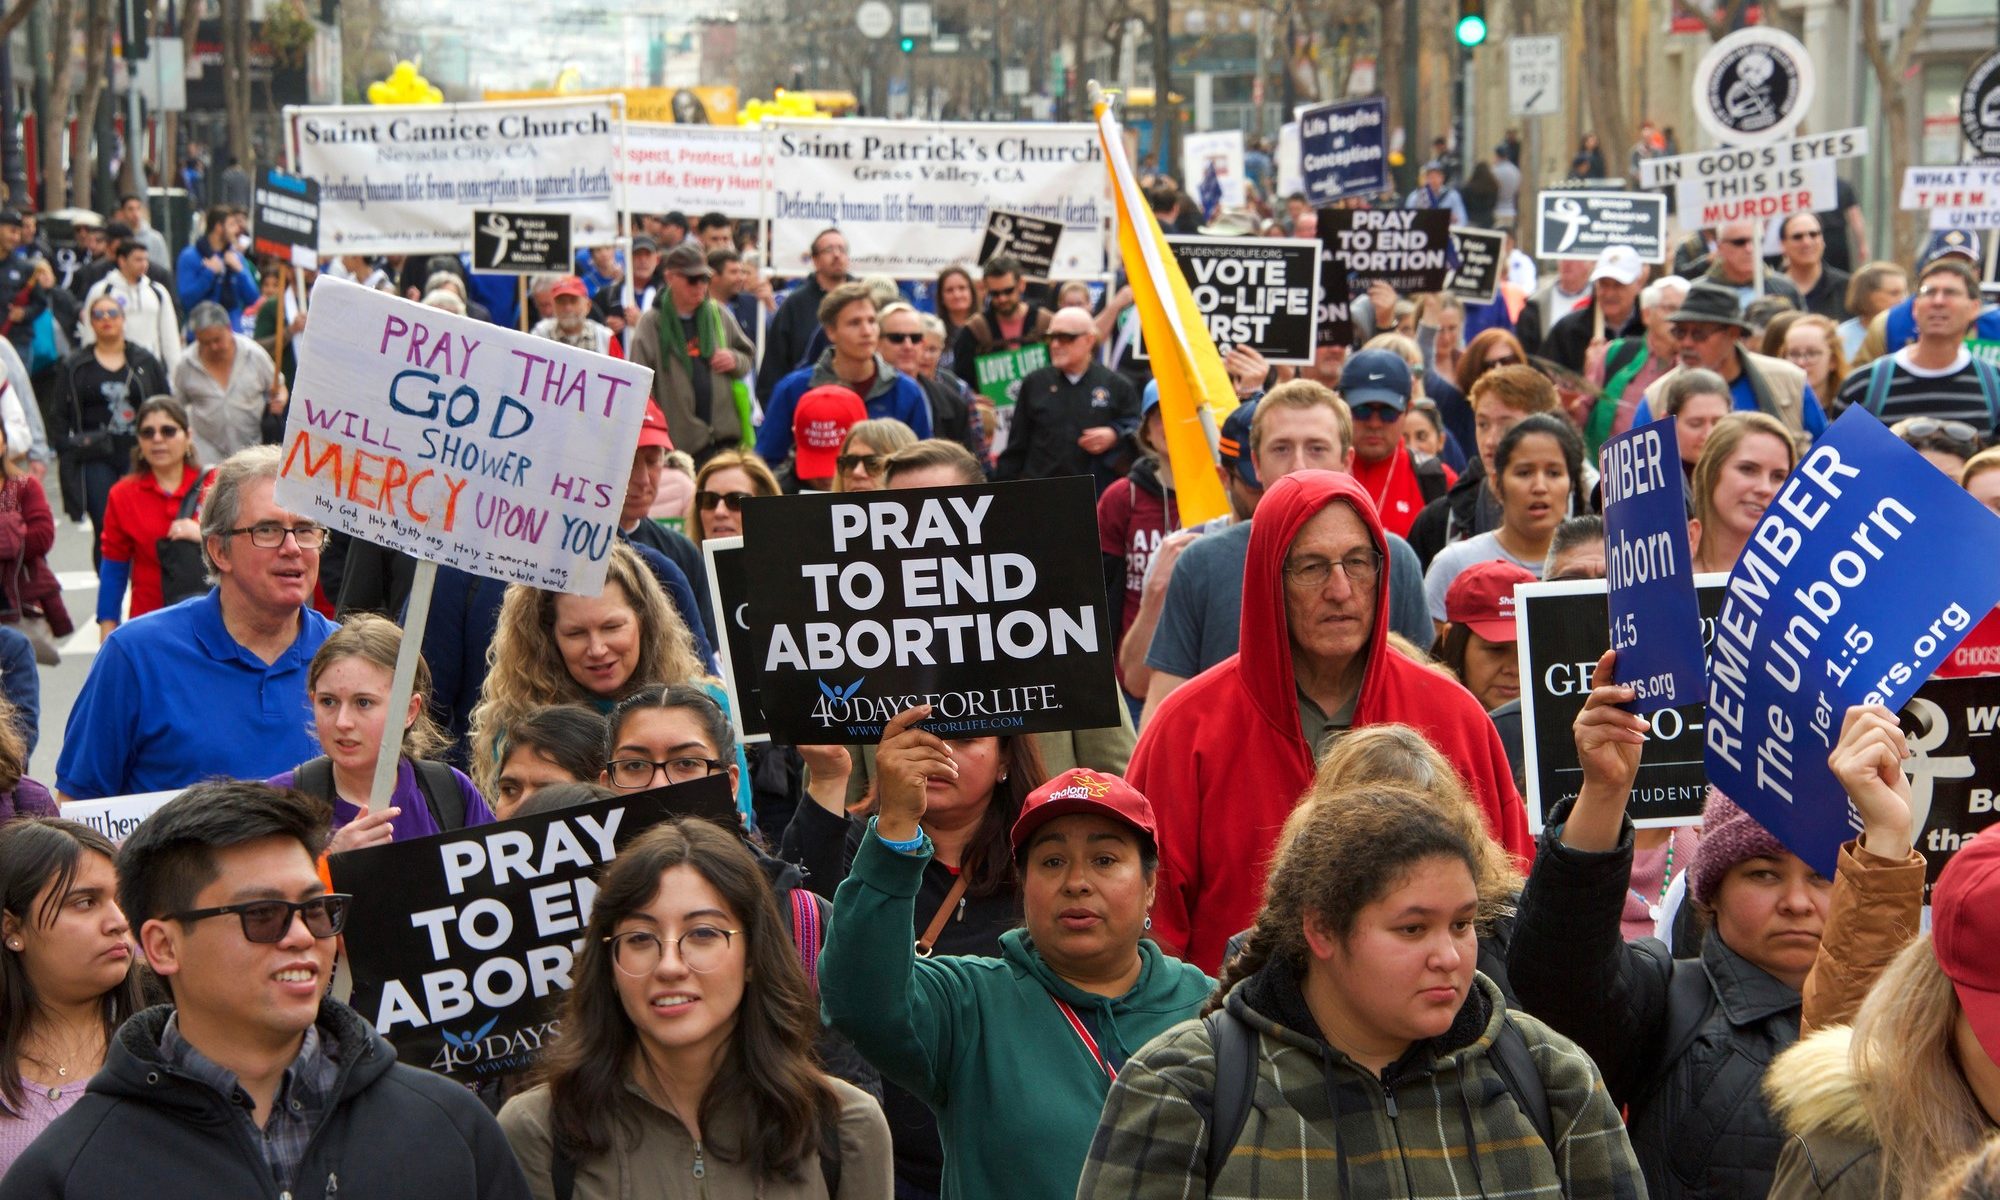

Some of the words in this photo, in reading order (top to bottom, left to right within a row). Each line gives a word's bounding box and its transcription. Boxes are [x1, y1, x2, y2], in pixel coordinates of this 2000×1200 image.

[305, 118, 380, 145] Saint
[389, 116, 489, 142] Canice
[498, 111, 609, 139] Church
[780, 131, 854, 159] Saint
[863, 135, 988, 162] Patrick's
[997, 137, 1101, 163] Church
[376, 146, 448, 163] Nevada
[506, 142, 538, 159] CA
[1654, 161, 1682, 181] IN
[1699, 147, 1776, 176] GOD'S
[1792, 135, 1854, 162] EYES
[366, 174, 405, 200] human
[427, 170, 455, 199] from
[458, 168, 519, 206] conception
[682, 172, 725, 193] Every
[854, 166, 913, 181] Grass
[994, 167, 1025, 183] CA
[1705, 174, 1767, 199] THIS
[1778, 168, 1804, 187] IS
[1913, 172, 1968, 186] WHAT
[776, 190, 838, 225] Defending
[841, 193, 880, 223] human
[1352, 210, 1417, 230] PRAY
[1703, 191, 1813, 223] MURDER
[1179, 247, 1284, 259] STUDENTSFORLIFE.ORG
[1337, 231, 1372, 251] TO
[1376, 231, 1429, 250] END
[1190, 257, 1287, 286] VOTE
[1192, 284, 1309, 315] O-LIFE
[1202, 314, 1271, 344] IRST
[380, 314, 481, 379] PRAY
[511, 350, 632, 418] THAT
[979, 354, 1015, 385] LOVE
[1016, 346, 1046, 377] LIFE
[389, 369, 534, 439] GOD
[304, 399, 402, 451] WILL
[417, 428, 533, 488] SHOWER
[550, 472, 613, 508] HIS
[1600, 429, 1666, 509] EMBER
[280, 430, 469, 532] MERCY
[475, 491, 549, 545] UPON
[561, 513, 613, 562] YOU
[315, 495, 334, 513] Holy
[369, 514, 387, 528] Holy
[454, 542, 481, 559] Holy
[830, 494, 995, 552] PRAY
[342, 519, 365, 537] Have
[374, 533, 405, 551] Mercy
[424, 552, 435, 560] us
[444, 557, 458, 566] and
[489, 565, 504, 576] the
[509, 569, 535, 581] whole
[542, 576, 567, 591] world.
[801, 560, 885, 613] TO
[901, 553, 1037, 608] END
[1765, 496, 1917, 693] Unborn
[1707, 444, 1861, 773] REMEMBER
[764, 604, 1099, 672] ABORTION
[1615, 612, 1638, 650] 1:5
[1810, 690, 1835, 749] Jer
[1826, 622, 1875, 688] 1:5
[853, 693, 919, 722] DAYS
[922, 691, 992, 720] FOR
[1756, 704, 1796, 803] The
[1048, 785, 1089, 802] Shalom
[440, 807, 626, 895] PRAY
[411, 898, 514, 961] TO
[374, 937, 586, 1036] ABOR
[484, 1019, 562, 1060] DAYS
